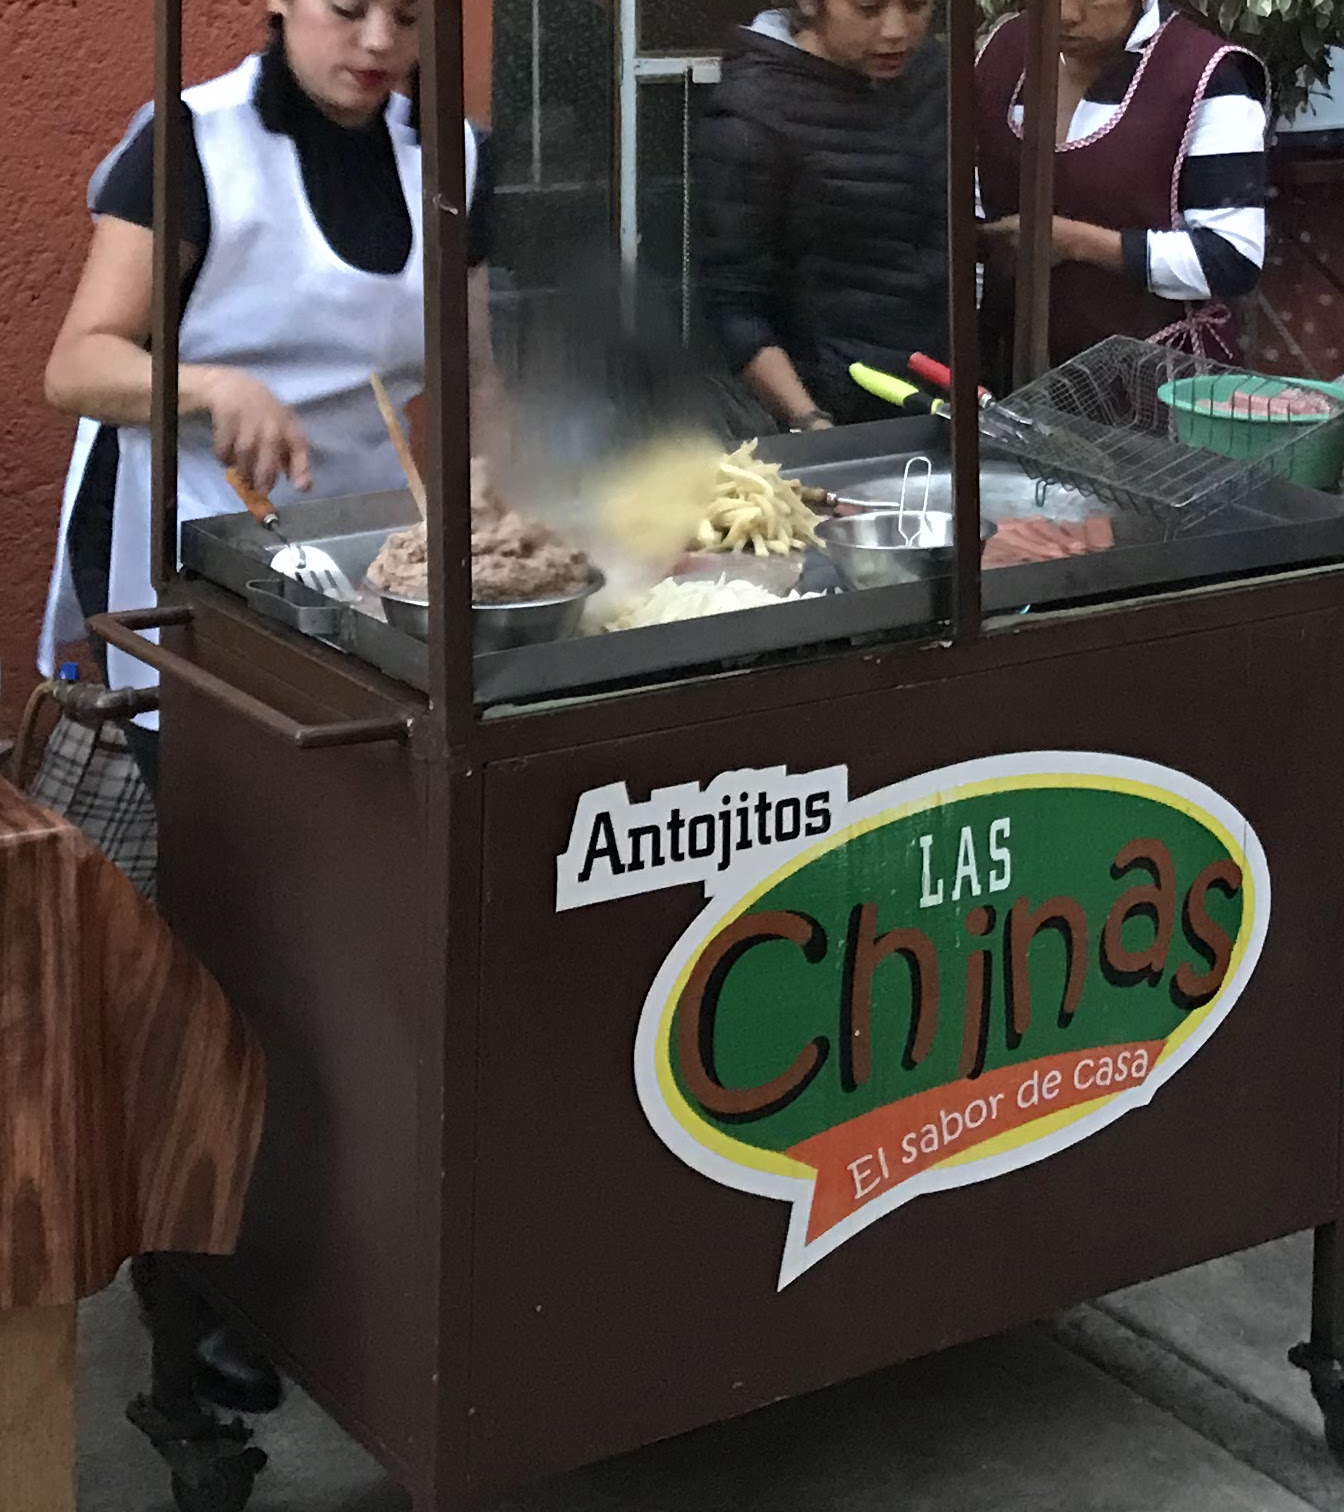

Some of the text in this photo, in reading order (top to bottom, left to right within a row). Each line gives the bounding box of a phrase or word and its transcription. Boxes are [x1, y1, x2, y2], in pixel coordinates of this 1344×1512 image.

[577, 789, 832, 884] Antojitos
[918, 816, 1014, 909] LAS
[678, 838, 1244, 1123] Chinas
[846, 1147, 890, 1200] El
[901, 1091, 1005, 1165] sabor
[1016, 1068, 1063, 1109] de
